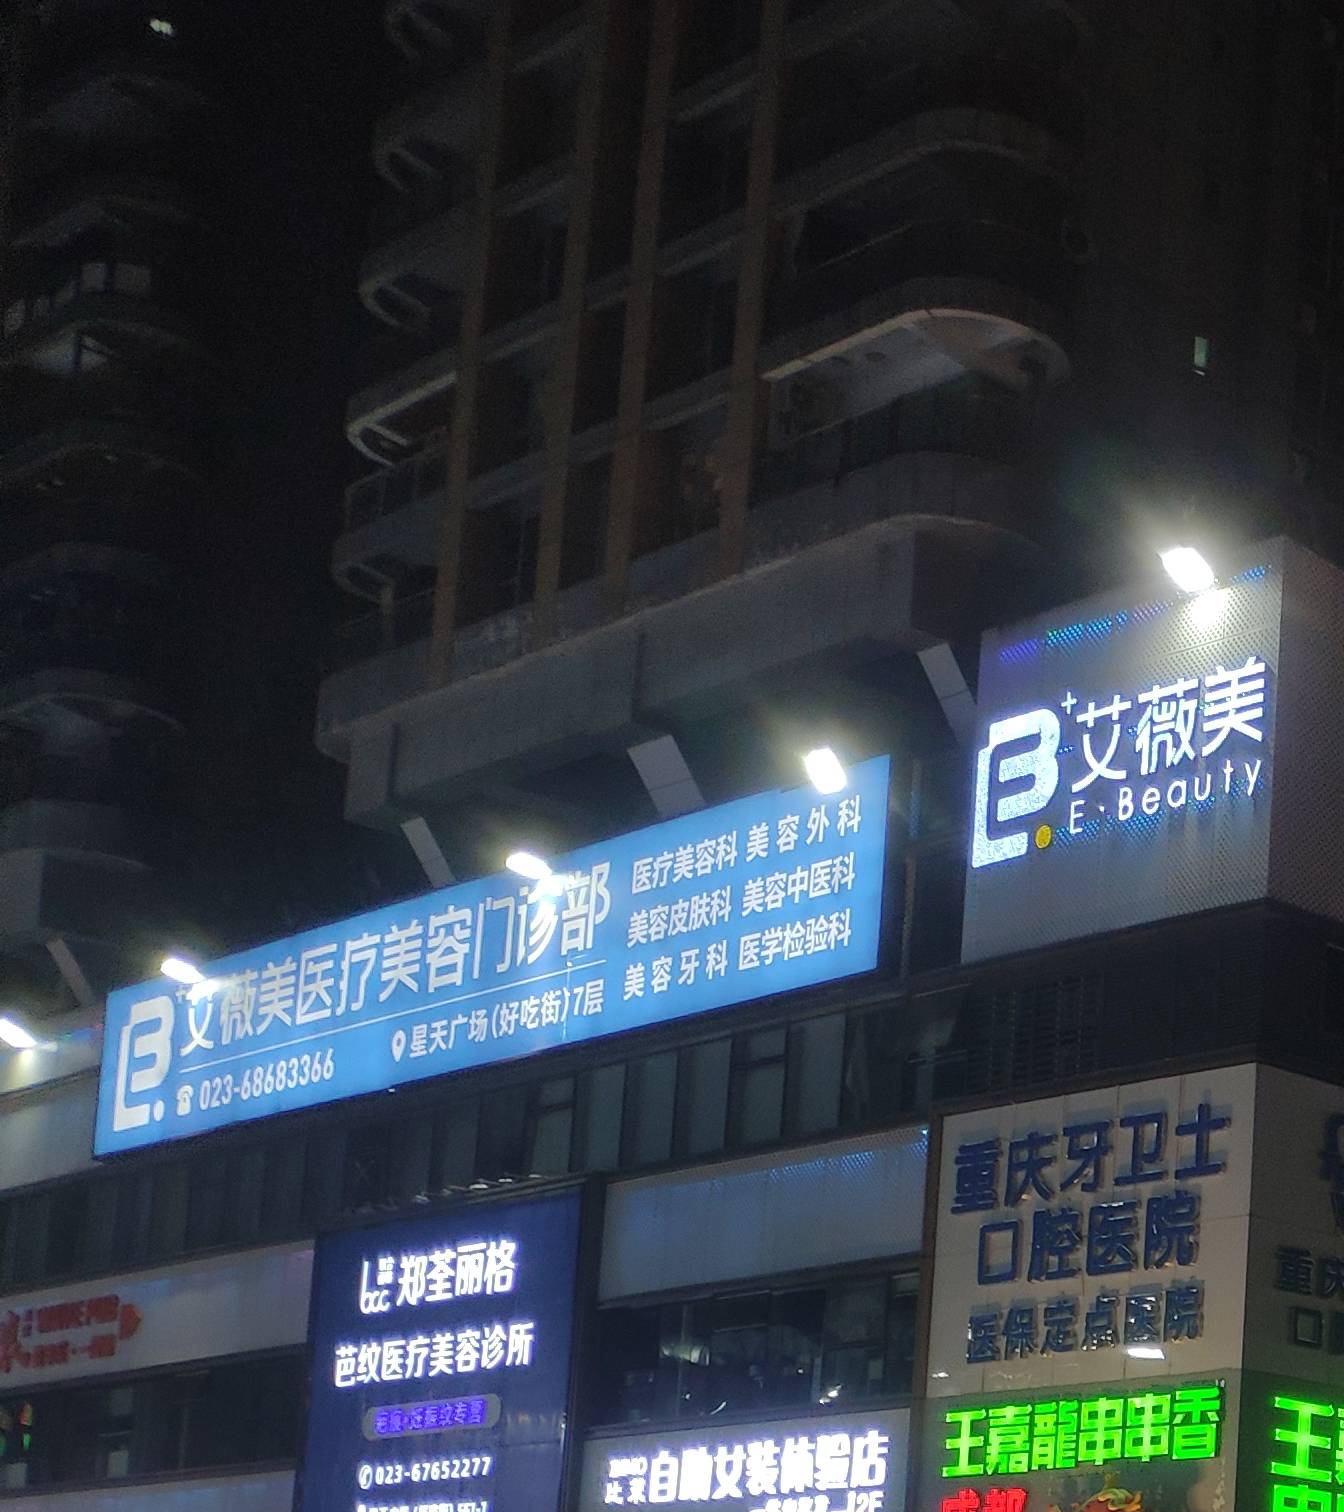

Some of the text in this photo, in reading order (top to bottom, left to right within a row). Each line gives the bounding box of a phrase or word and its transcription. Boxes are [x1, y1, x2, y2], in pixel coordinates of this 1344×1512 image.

[1070, 655, 1267, 793] 艾薇美
[631, 797, 861, 896] 医疗美容科 美容外科
[628, 853, 856, 948] 美容皮肤科 美容中医科
[179, 862, 611, 1055] 艾薇美医疗美容门诊部
[624, 910, 852, 999] 美容牙科 医学检验科
[199, 1048, 335, 1114] 023-68683366
[951, 1103, 1231, 1214] 重庆牙卫士
[977, 1191, 1201, 1285] 口腔医院
[334, 1321, 534, 1388] 芭纹医疗美容诊所
[966, 1280, 1204, 1364] 医保定点医院
[375, 1456, 492, 1486] 023-67652277
[650, 1430, 889, 1502] 自助女装体验店
[941, 1385, 1225, 1478] 王嘉龍串串香
